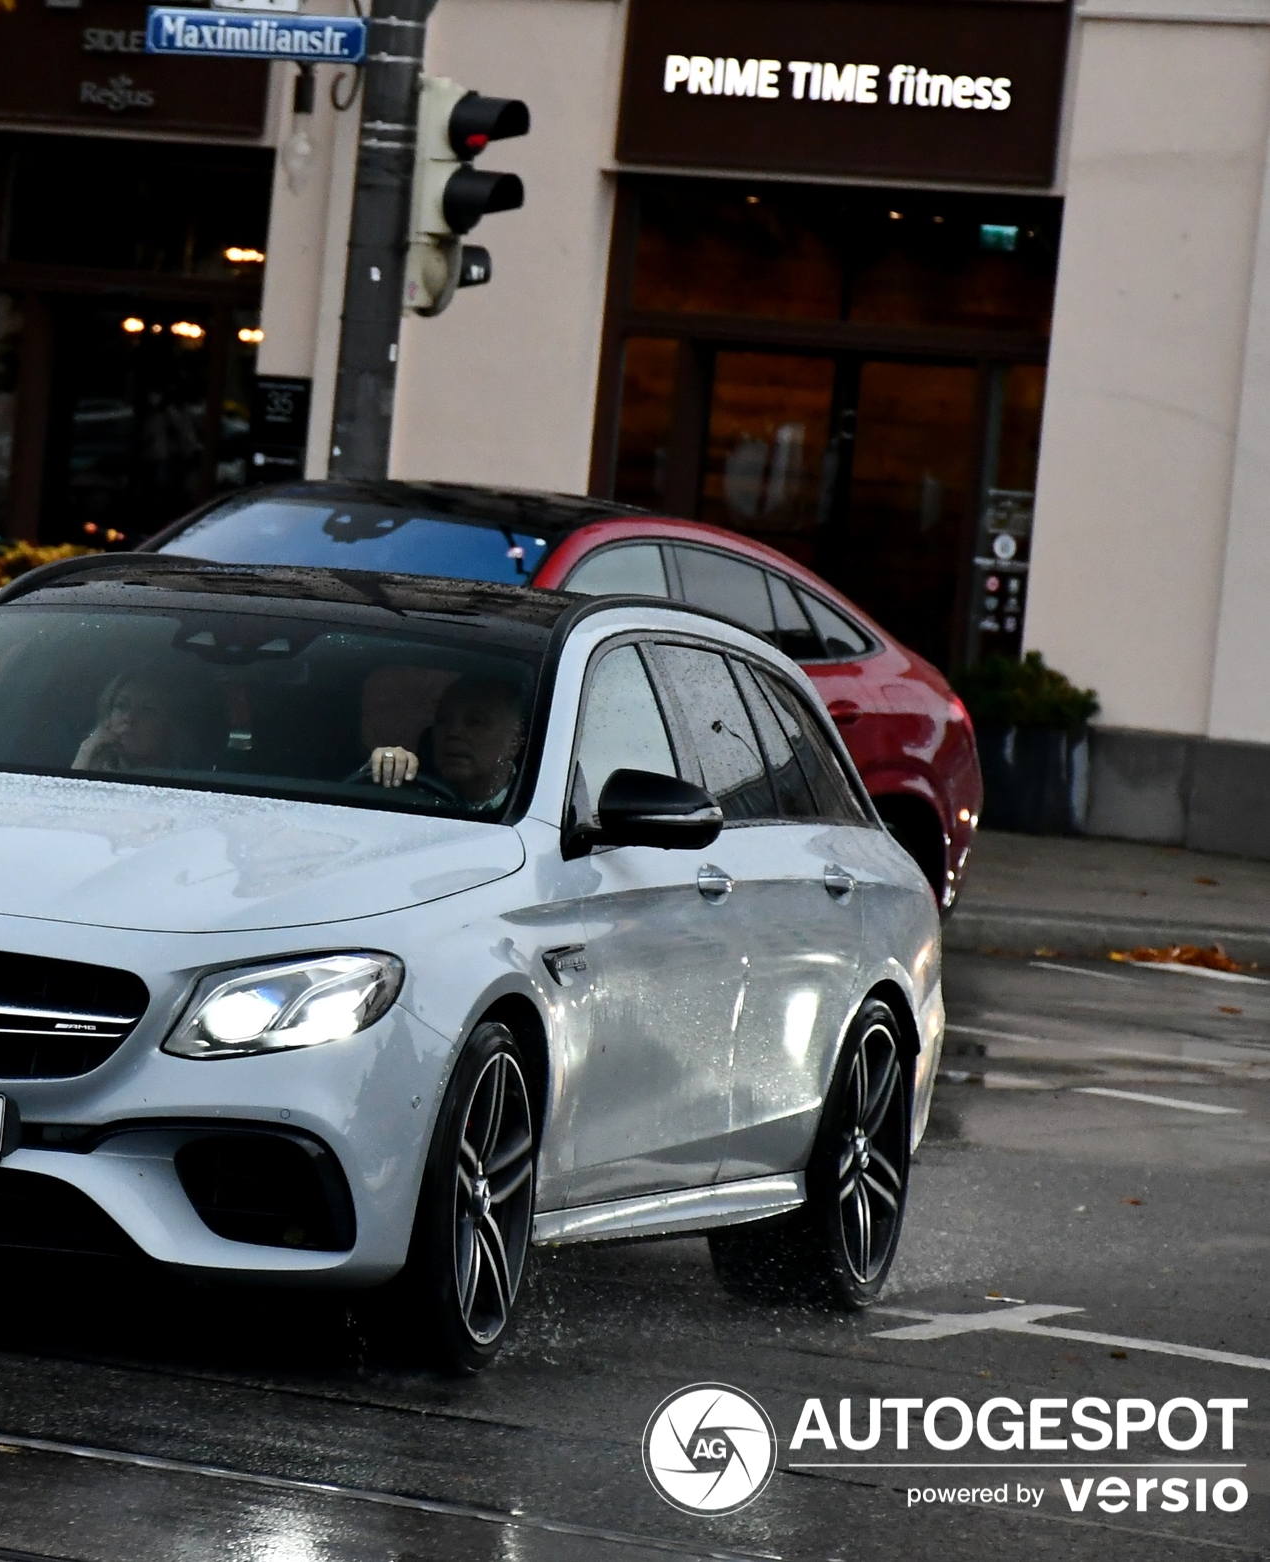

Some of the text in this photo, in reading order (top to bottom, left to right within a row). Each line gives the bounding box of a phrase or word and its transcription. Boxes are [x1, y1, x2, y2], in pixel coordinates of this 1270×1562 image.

[161, 15, 349, 55] Maximilianstr.
[664, 55, 1011, 110] PRIME TIME fitness
[68, 1023, 96, 1031] AMG
